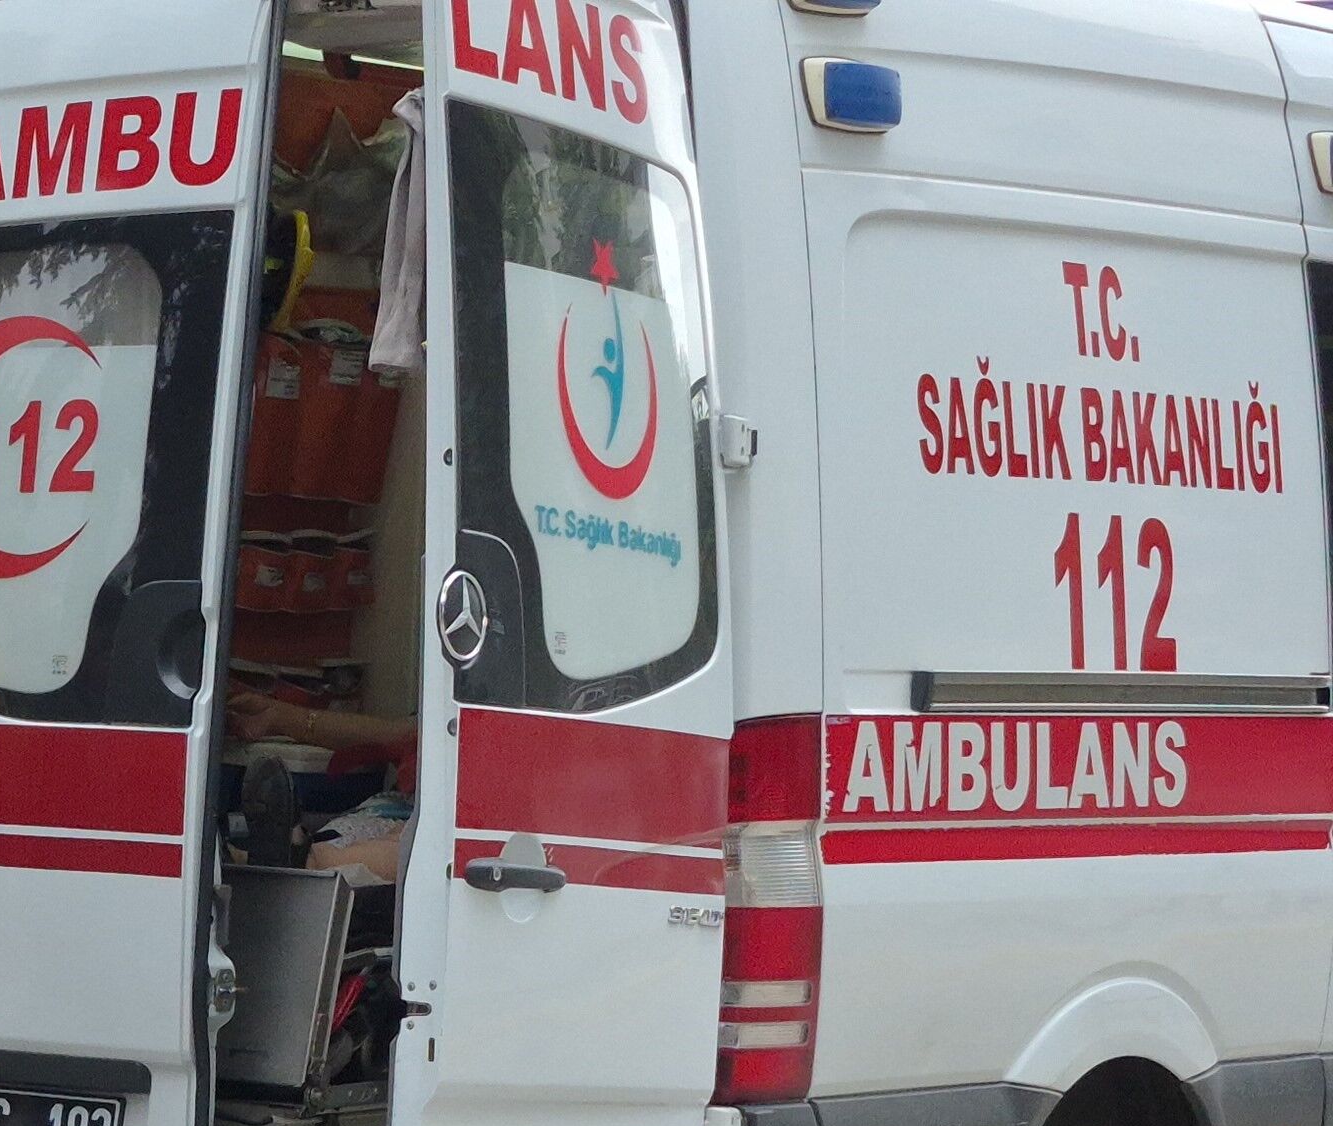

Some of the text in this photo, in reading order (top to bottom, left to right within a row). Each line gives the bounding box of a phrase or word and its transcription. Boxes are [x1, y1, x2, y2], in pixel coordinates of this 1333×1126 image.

[451, 0, 648, 125] LANS
[1062, 260, 1141, 362] T.C.
[916, 355, 1283, 494] SAĞLIK BAKANLIĞI
[534, 504, 562, 537] T.C.
[1053, 511, 1178, 672] 112
[841, 719, 1188, 813] AMBULANS
